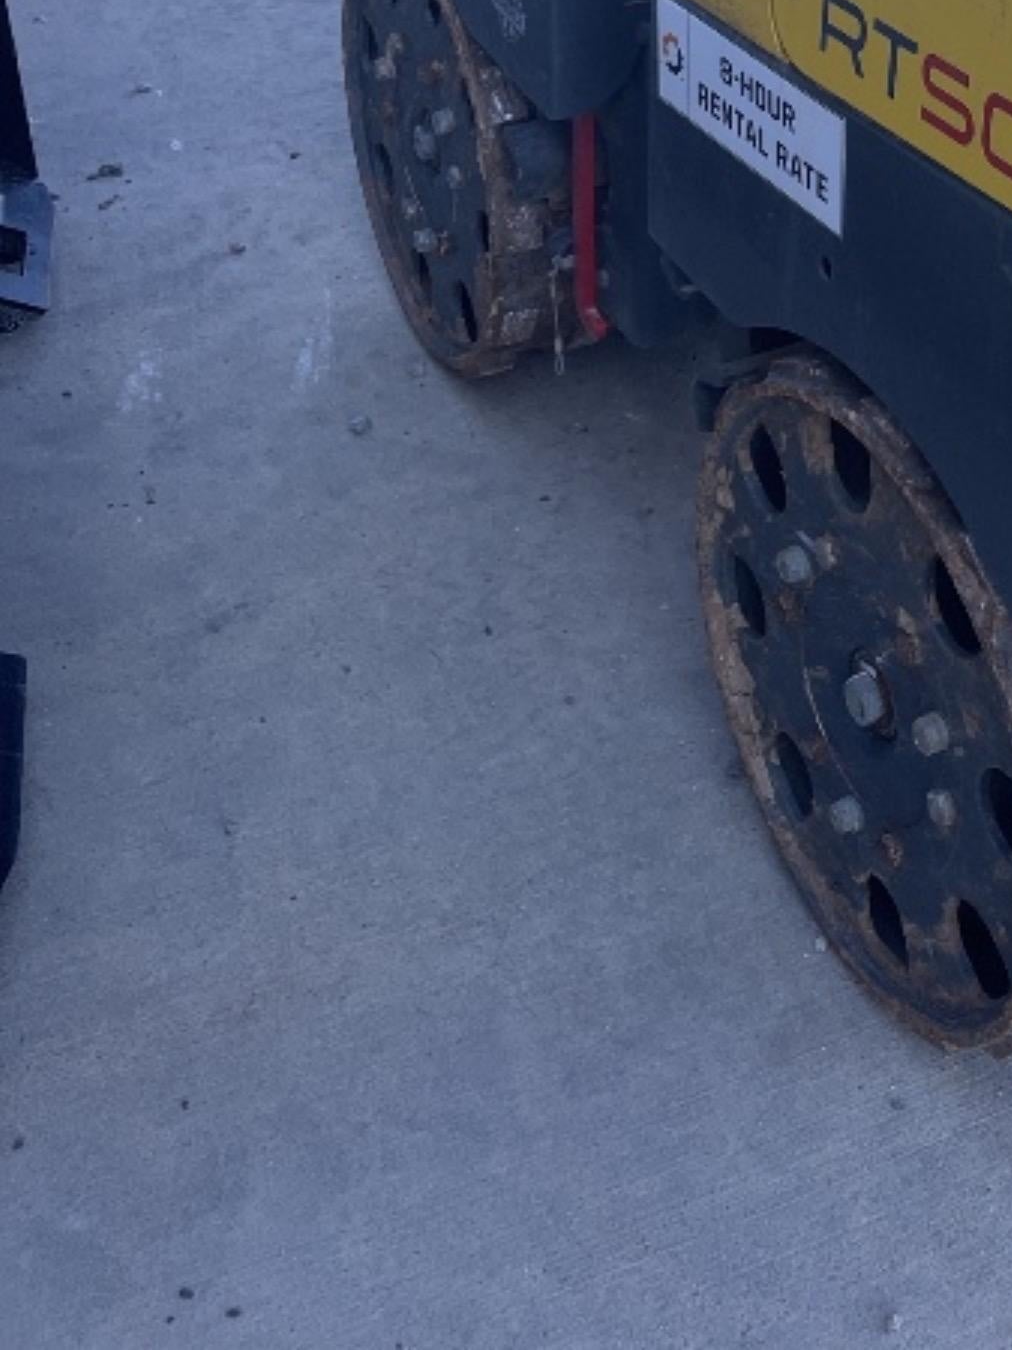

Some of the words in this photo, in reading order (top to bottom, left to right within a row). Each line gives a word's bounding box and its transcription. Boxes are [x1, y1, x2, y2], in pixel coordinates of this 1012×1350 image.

[697, 82, 768, 158] RENTAL
[775, 140, 829, 205] RATE
[719, 56, 796, 135] 8-HOUR
